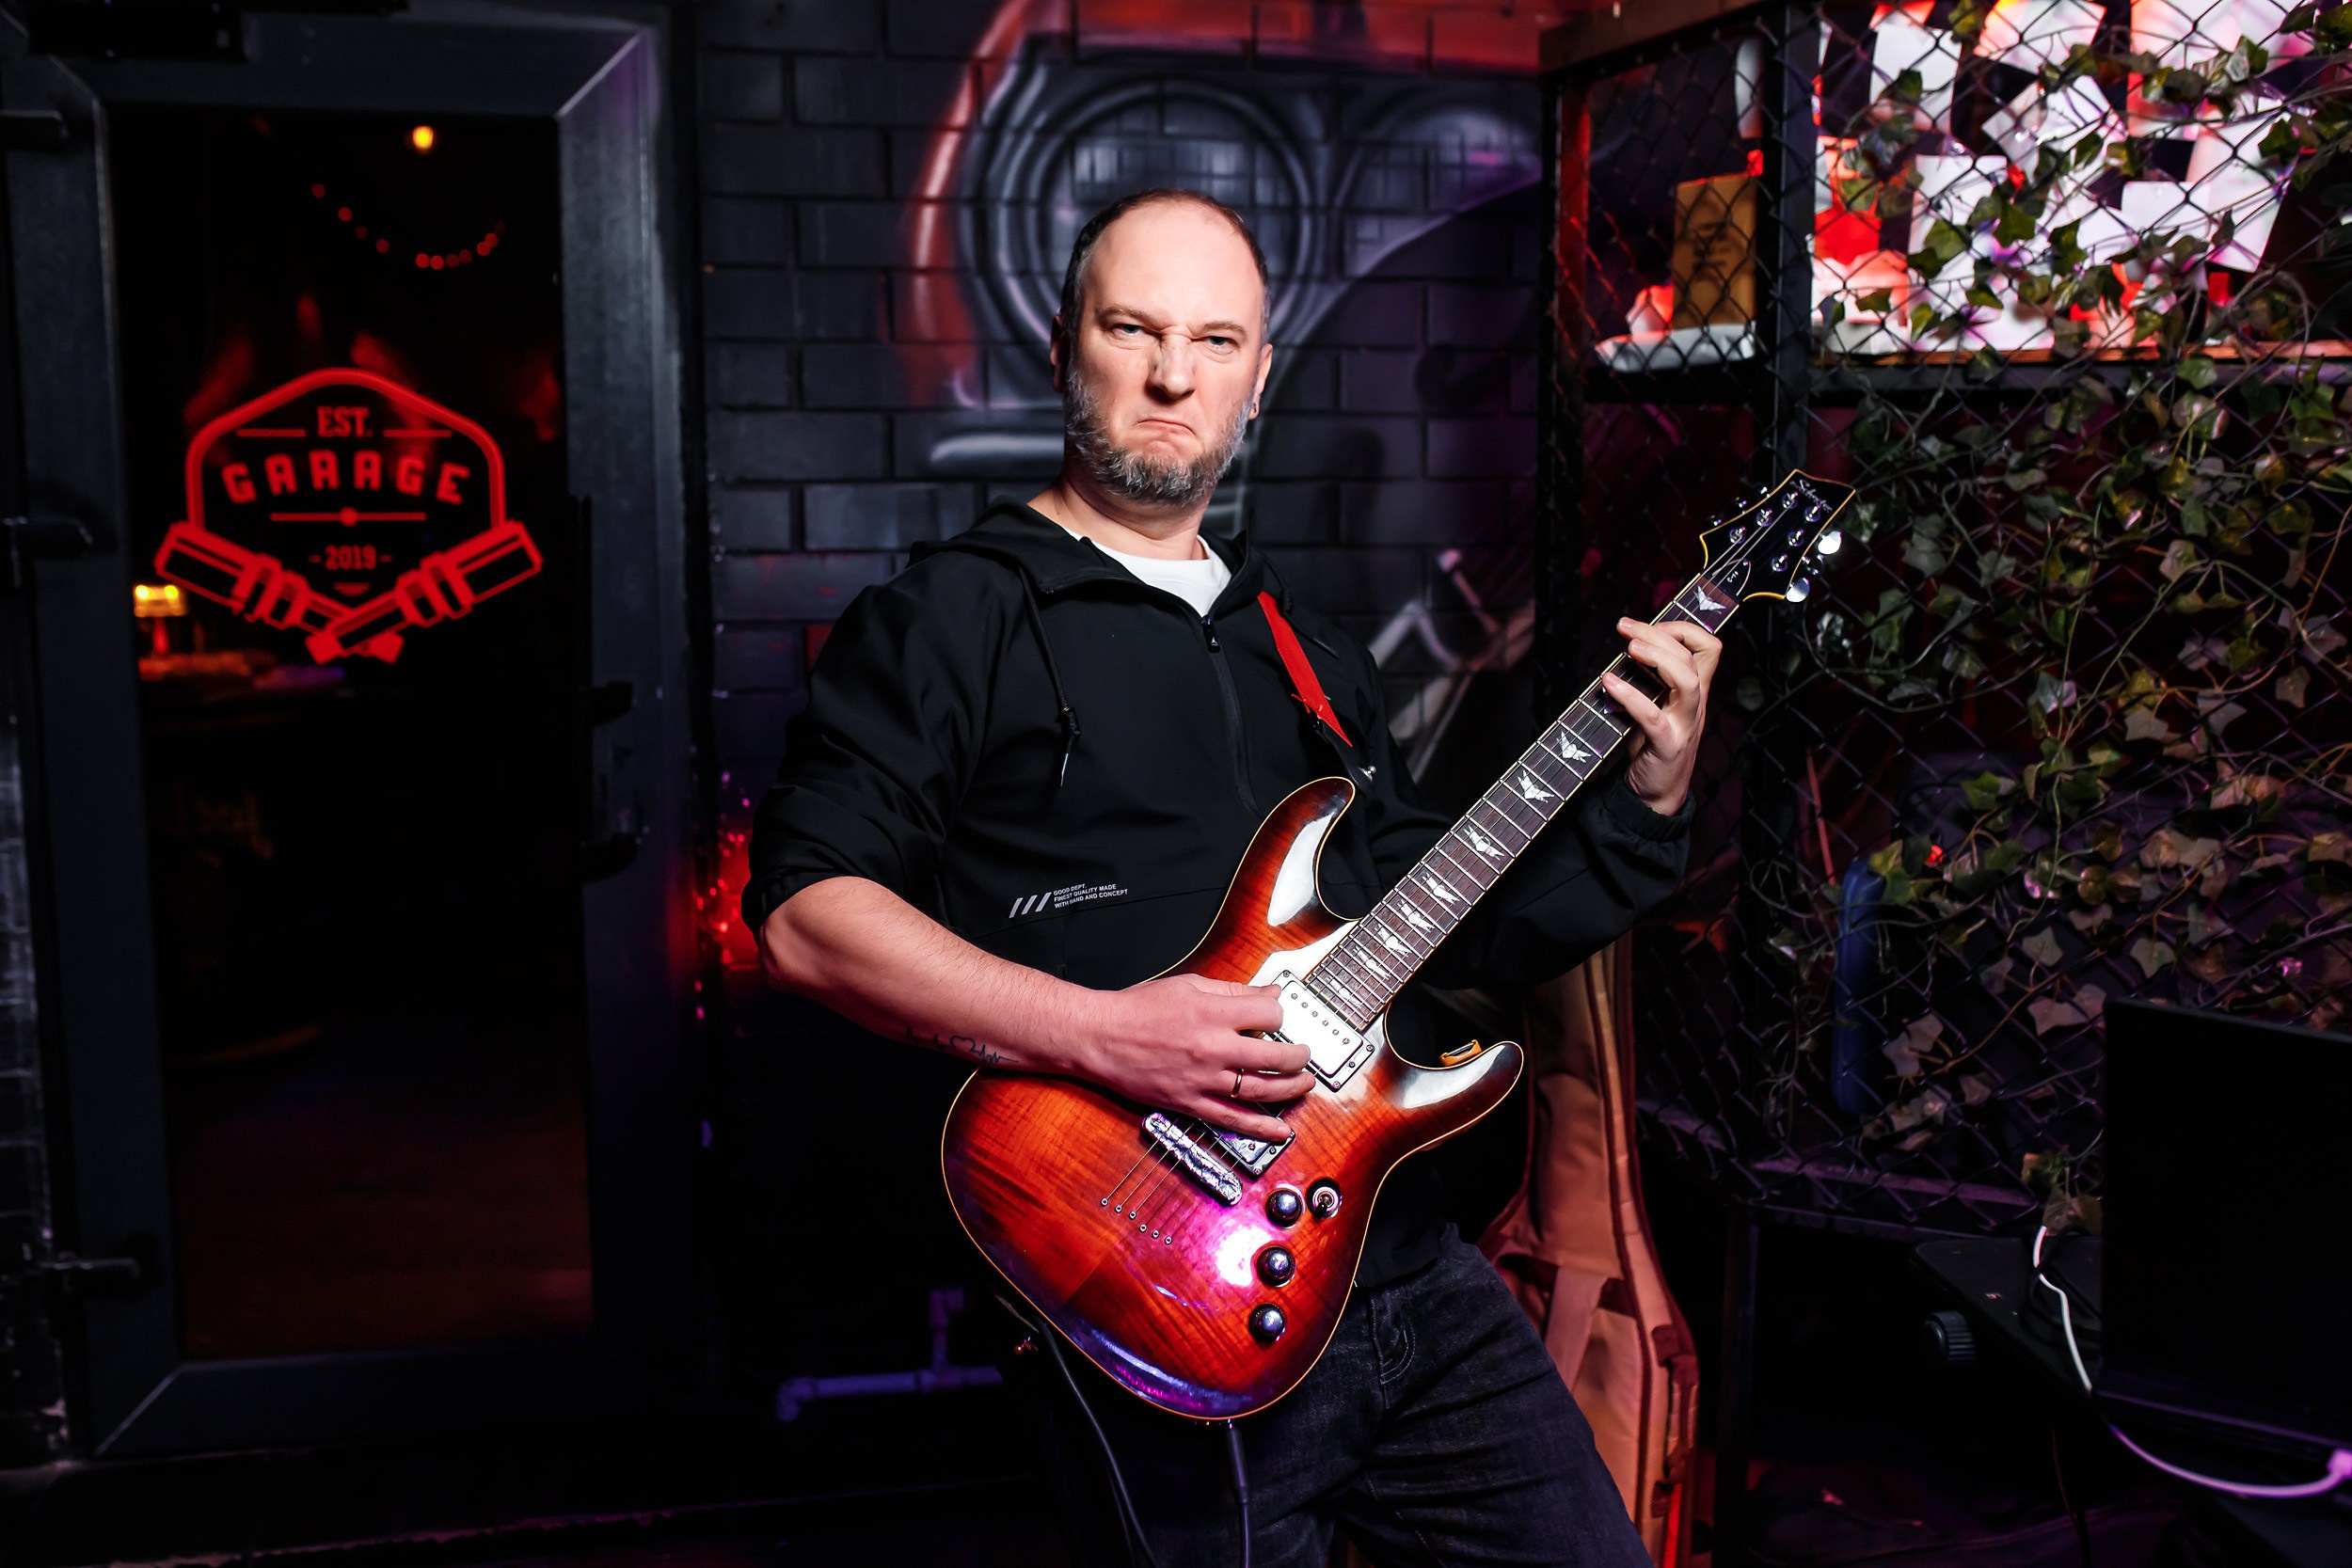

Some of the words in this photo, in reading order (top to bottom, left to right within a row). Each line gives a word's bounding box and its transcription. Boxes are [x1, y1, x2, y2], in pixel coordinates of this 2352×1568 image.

[317, 406, 373, 438] EST.
[222, 450, 470, 504] GARAGE
[325, 546, 378, 570] 2019
[1053, 887, 1070, 895] GOOD
[1054, 893, 1073, 902] FINEST
[1073, 887, 1098, 896] QUALITY
[1054, 900, 1070, 909] WITH
[1070, 896, 1084, 905] HAND
[1099, 889, 1128, 898] CONCEPT
